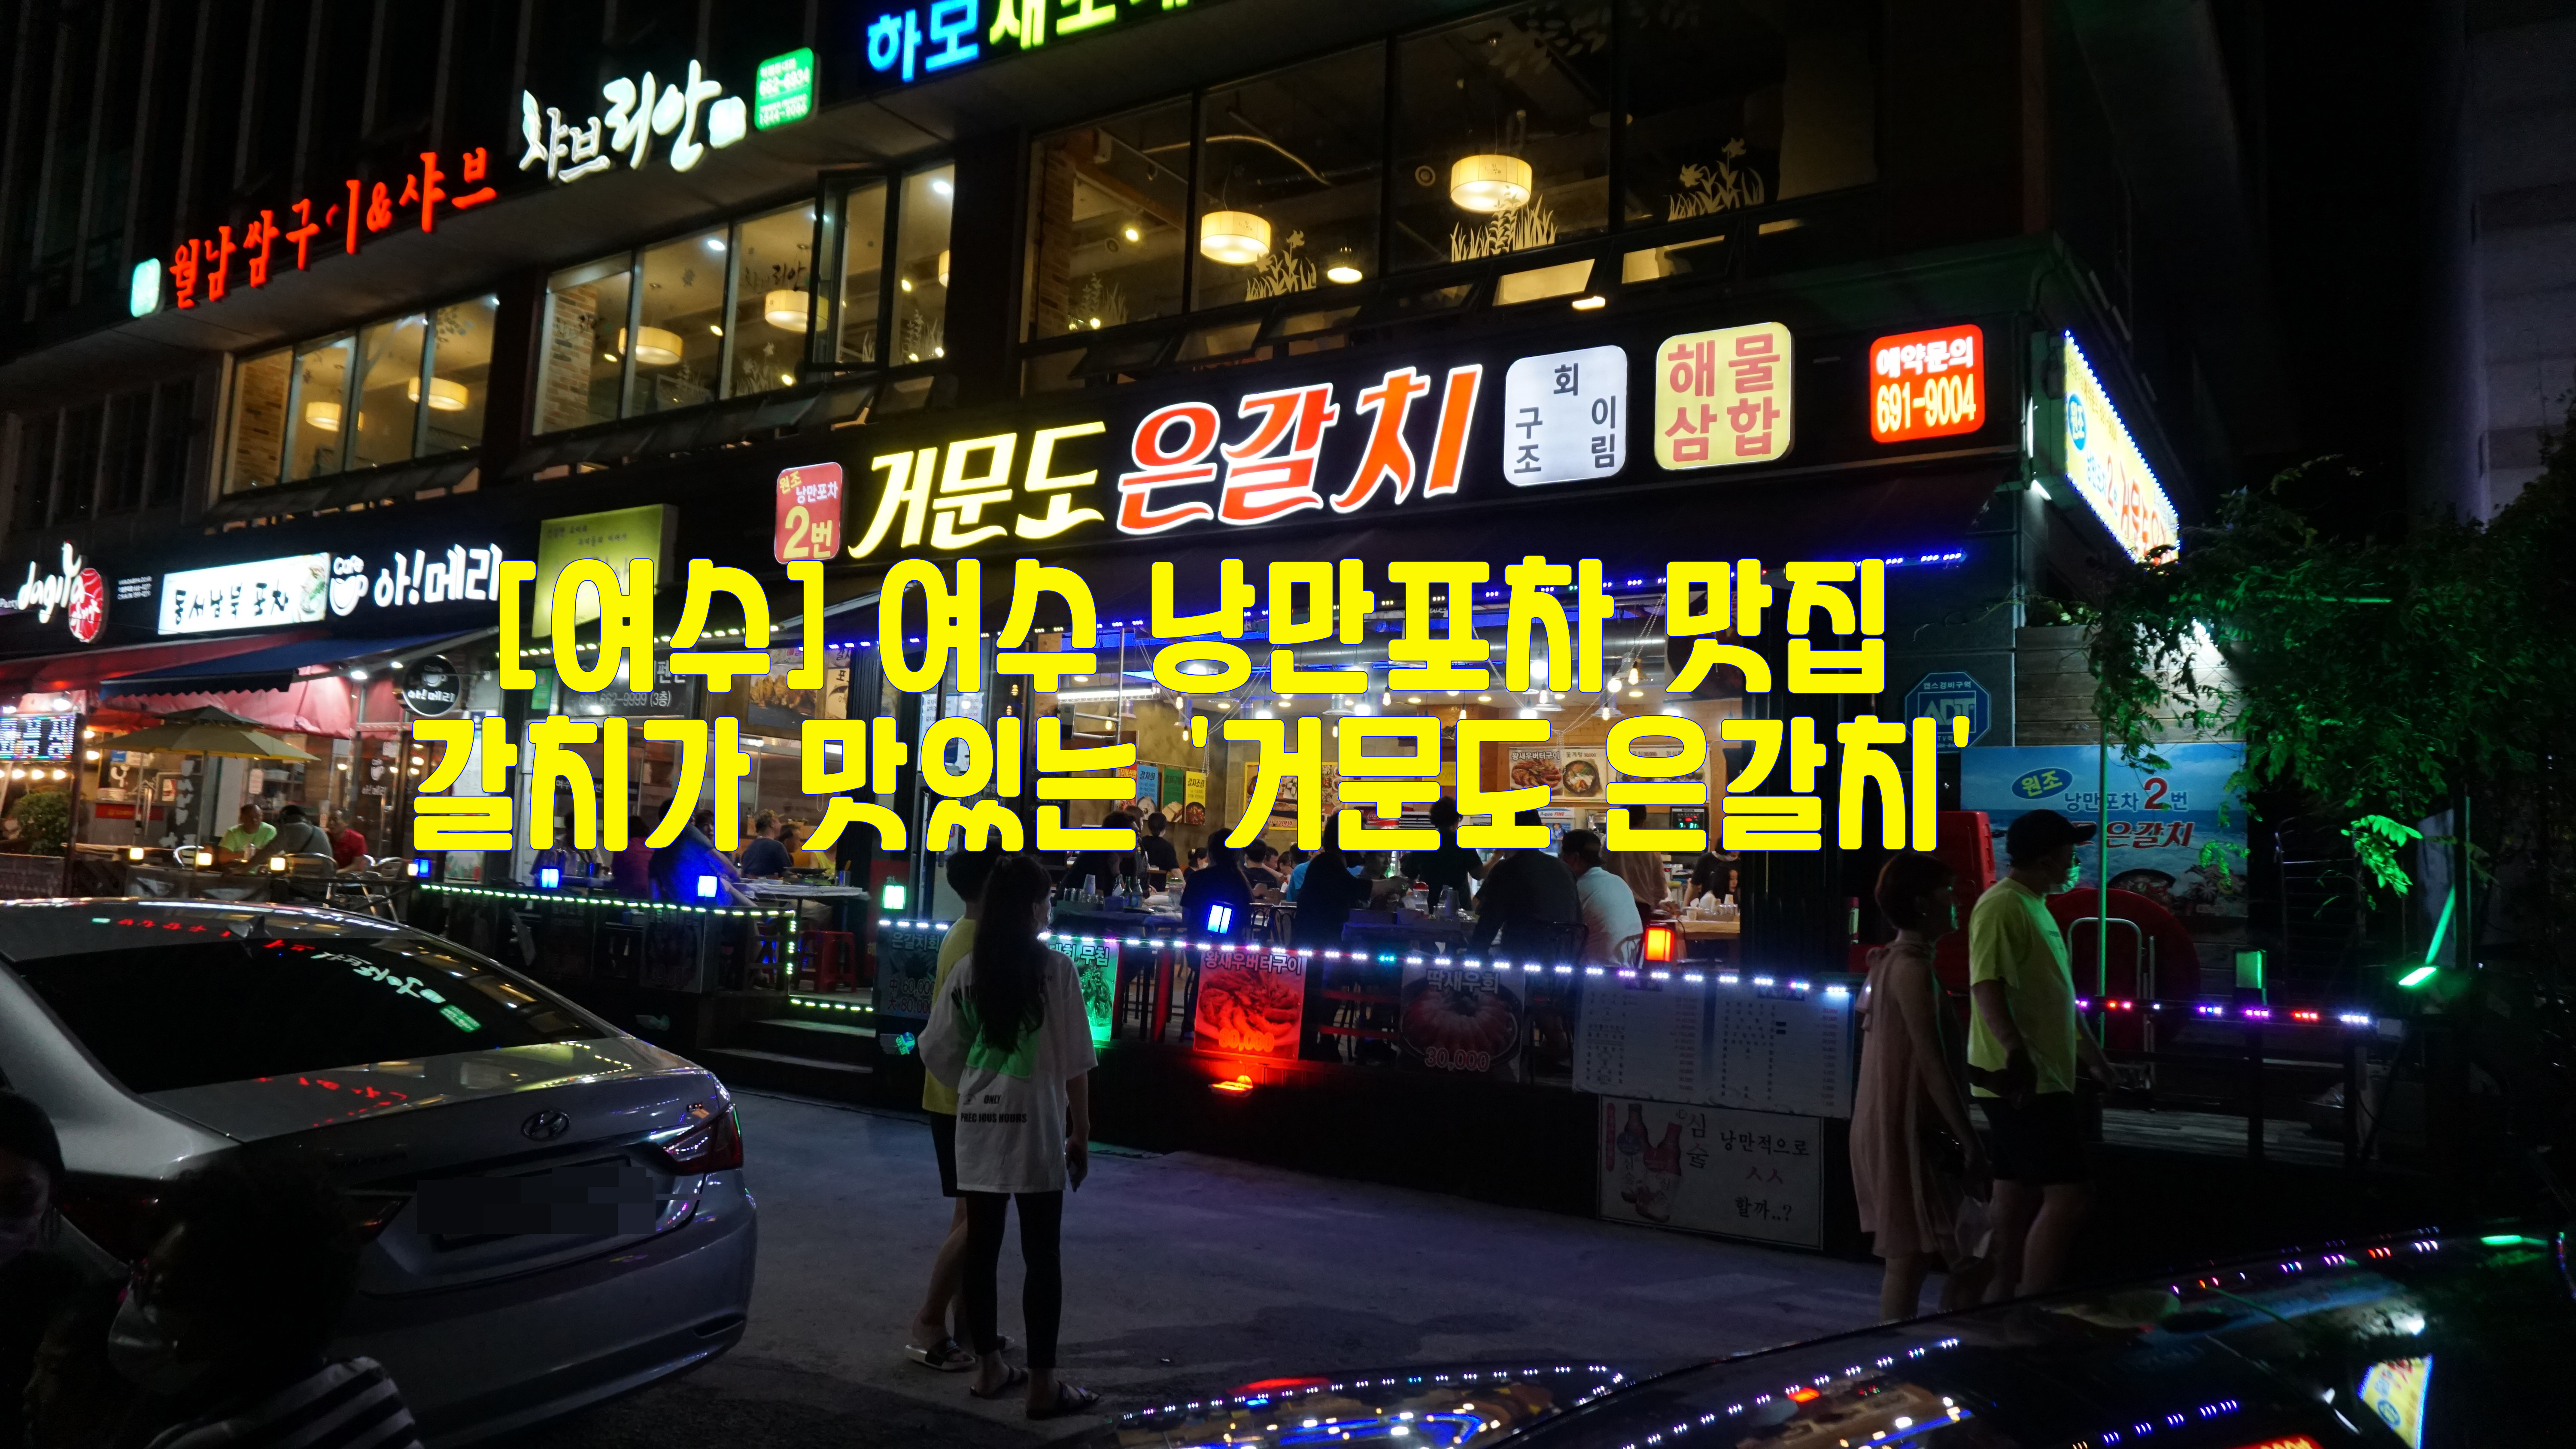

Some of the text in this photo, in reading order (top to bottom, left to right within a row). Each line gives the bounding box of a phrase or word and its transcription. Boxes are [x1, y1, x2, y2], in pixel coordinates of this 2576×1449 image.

[1667, 333, 1781, 397] 해물
[1876, 336, 1974, 378] 예약문의
[1876, 373, 1977, 433] 691-9004
[1664, 396, 1781, 463] 삼합
[2070, 400, 2085, 440] 원조
[849, 363, 1484, 559] 거문도 은갈치
[779, 470, 802, 494] 원조
[796, 481, 838, 504] 낭만포차
[783, 505, 832, 559] 2번
[333, 555, 364, 575] Cafe
[374, 543, 503, 607] 아!메리
[407, 689, 456, 703] 아!메리
[1923, 681, 1972, 690] 캡스경비구역
[650, 690, 672, 707] (3층)
[1922, 697, 1976, 725] ADT
[1511, 751, 1560, 761] 왕새우버터구이
[1139, 771, 1155, 781] 갈치회
[1188, 778, 1205, 788] 갈치조림
[2021, 770, 2063, 797] 원조
[2065, 791, 2139, 812] 낭만포차
[2105, 820, 2196, 849] 은갈치
[891, 932, 940, 953] 은갈치회
[1080, 946, 1109, 967] 무침
[1204, 950, 1303, 976] 왕새우버터구이
[1426, 969, 1500, 995] 딱새우회
[1424, 1046, 1491, 1072] 30,000
[983, 1095, 1001, 1104] ONLY
[998, 1113, 1027, 1123] HOURS
[1721, 1130, 1810, 1155] 낭만적으로
[1735, 1195, 1792, 1222] 할까..?
